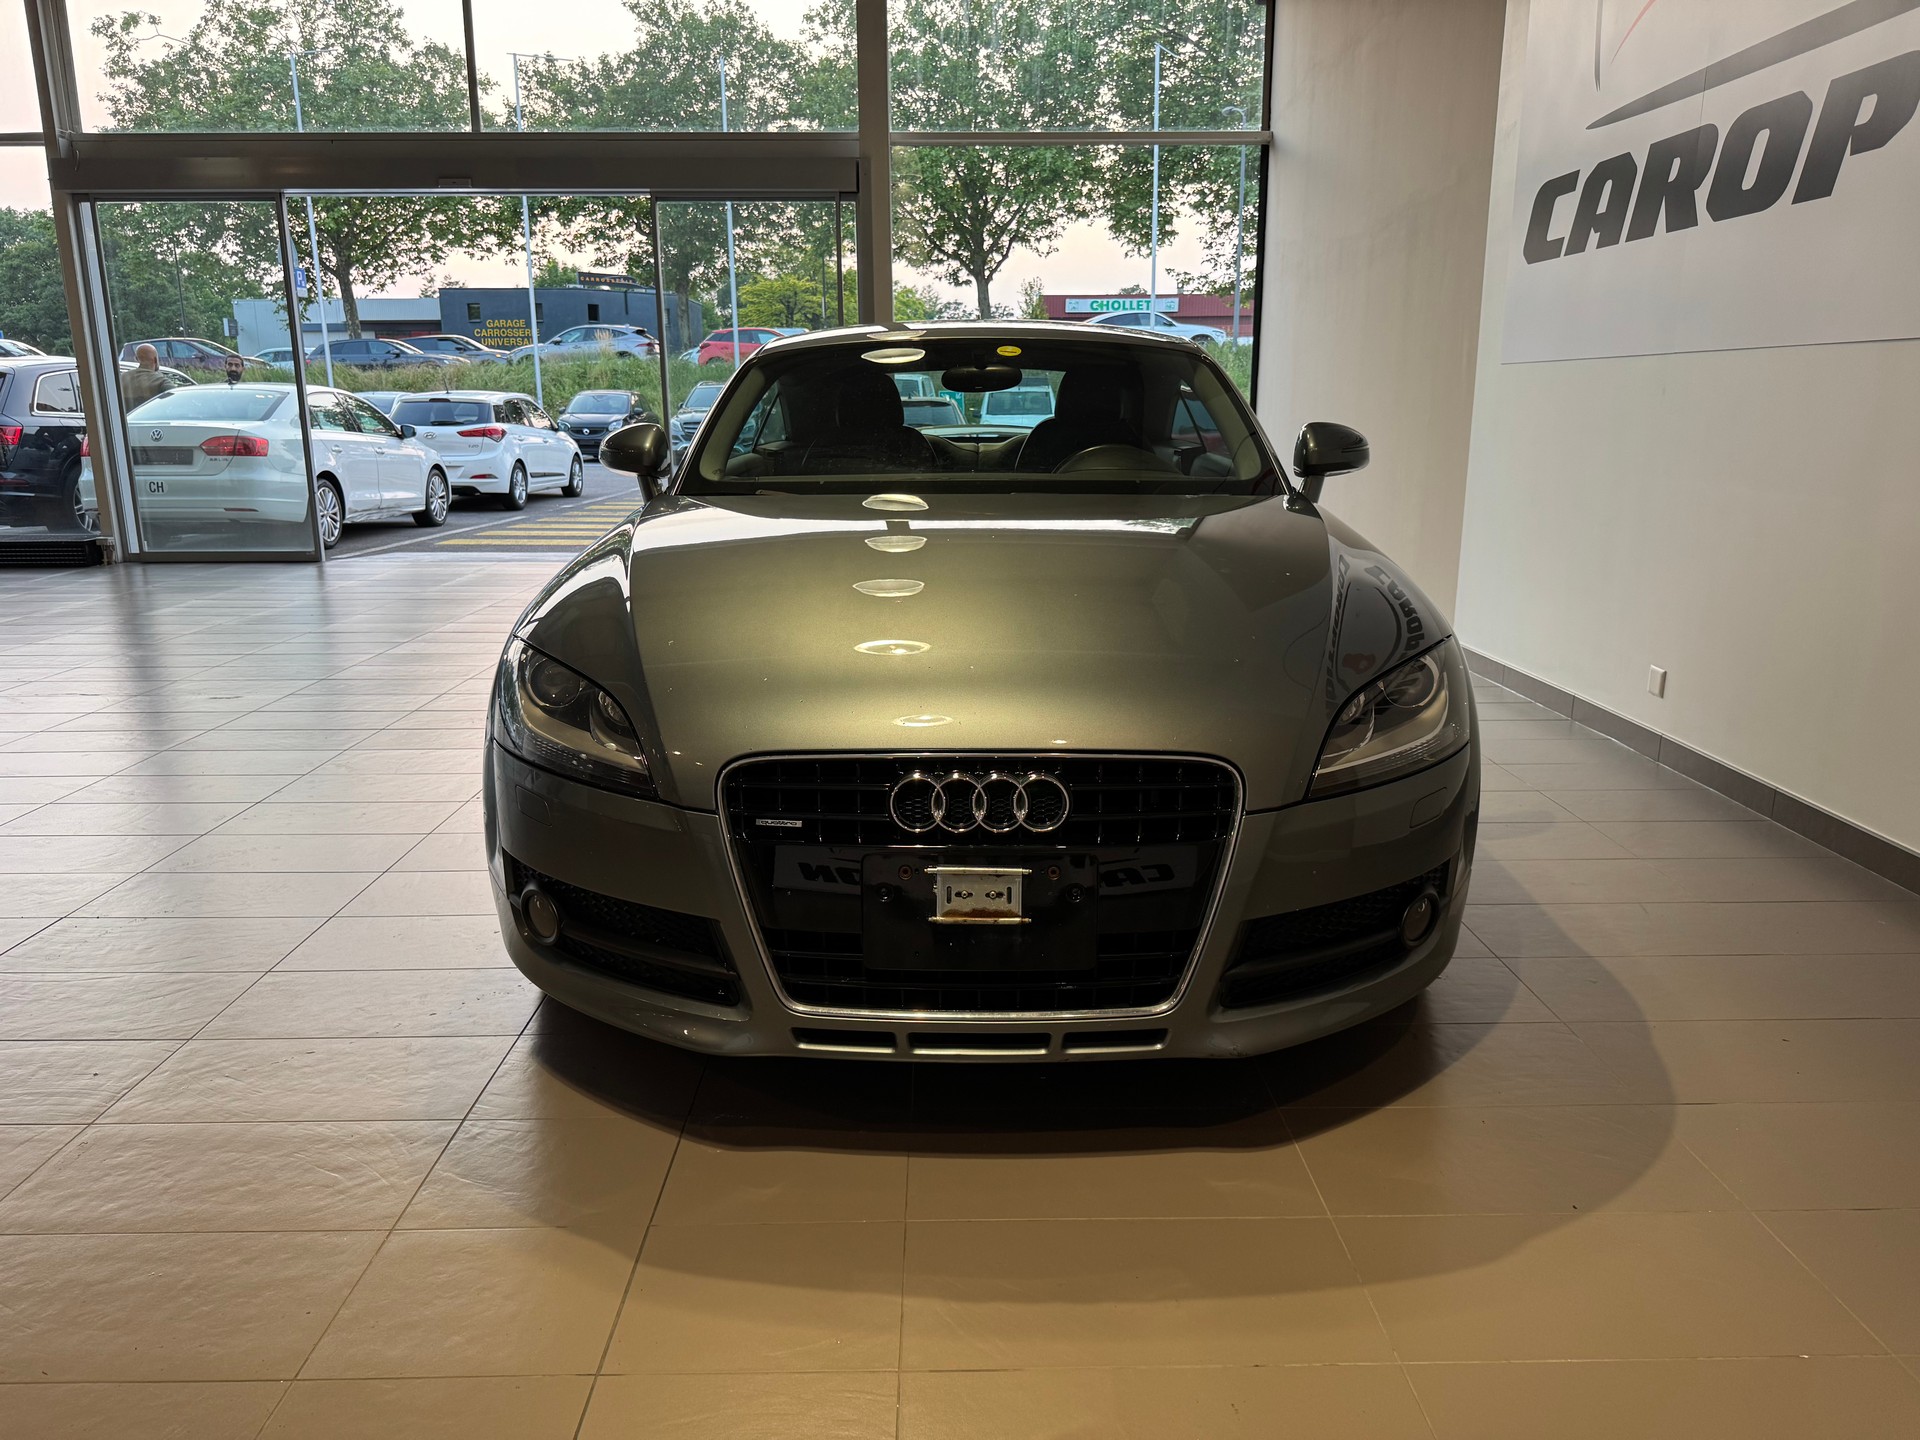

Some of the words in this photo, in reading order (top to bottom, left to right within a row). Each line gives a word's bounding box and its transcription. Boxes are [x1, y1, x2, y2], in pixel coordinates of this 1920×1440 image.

[1523, 49, 1920, 265] CAROP
[1090, 300, 1152, 311] CHOLLET
[486, 319, 526, 328] GARAGE
[474, 328, 540, 337] CARROSSERE
[149, 481, 165, 493] CH
